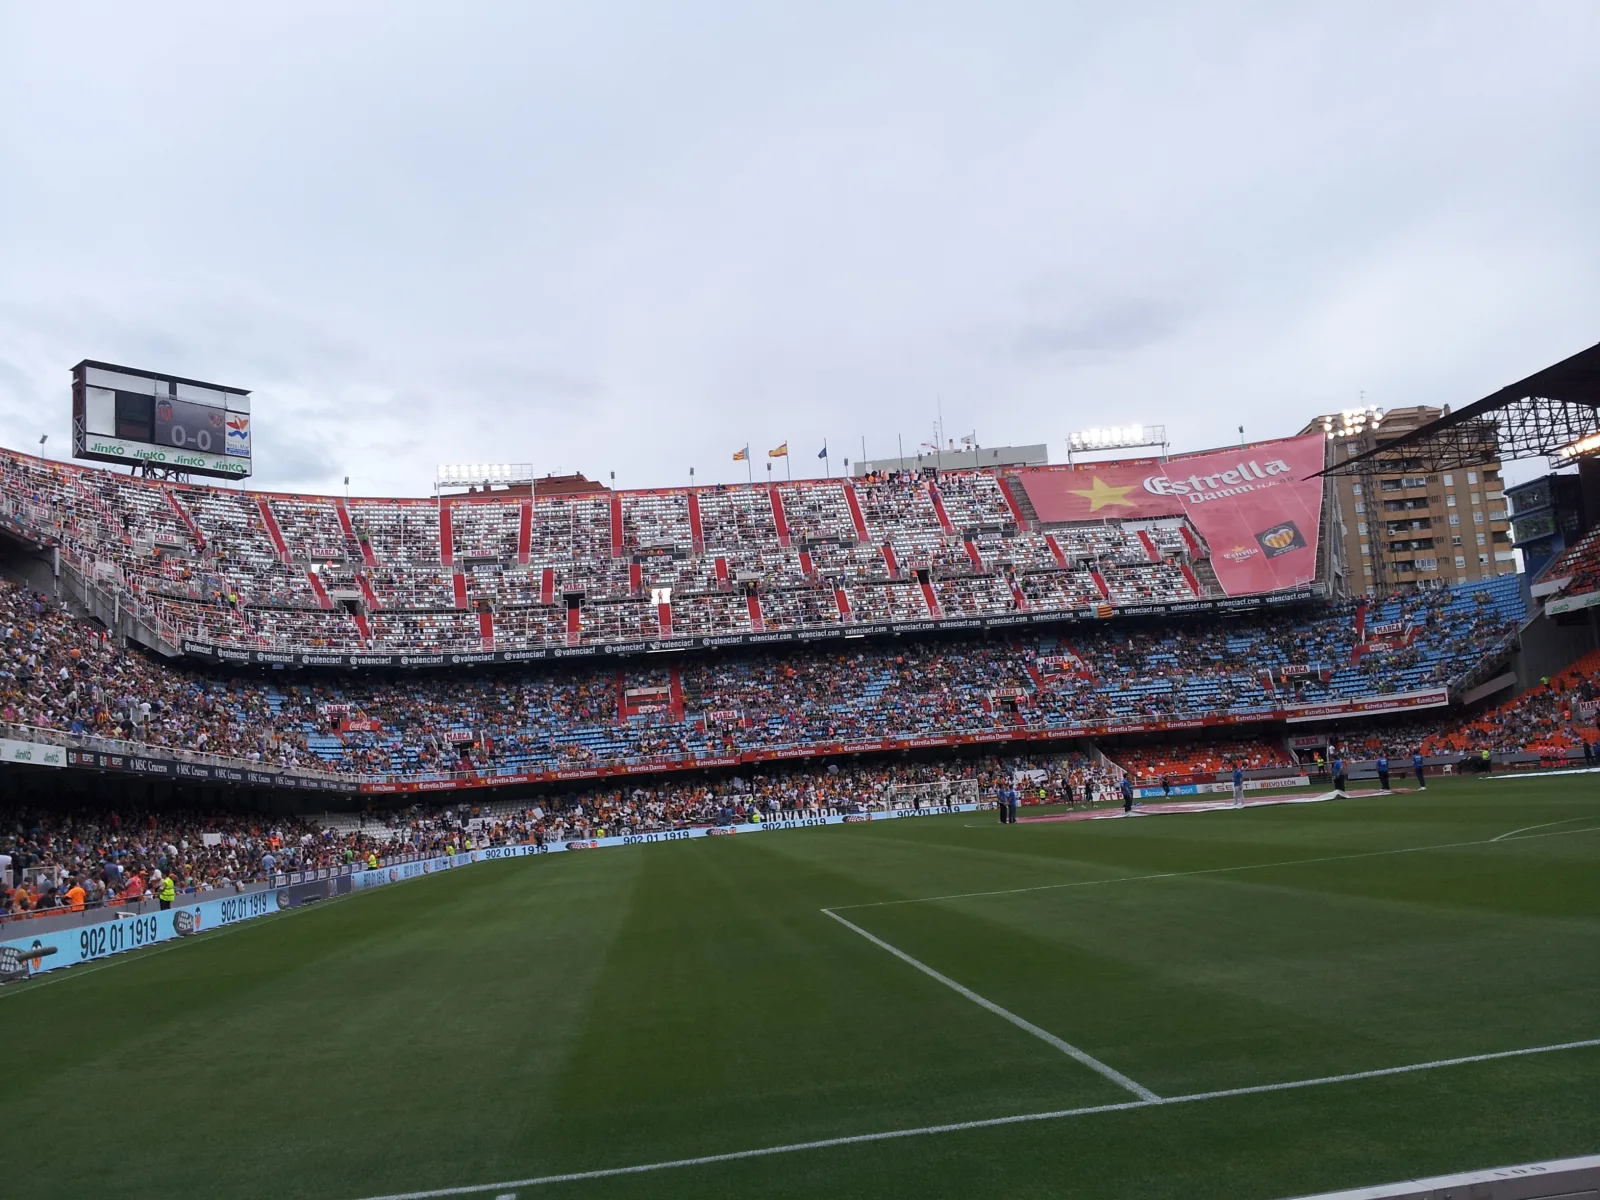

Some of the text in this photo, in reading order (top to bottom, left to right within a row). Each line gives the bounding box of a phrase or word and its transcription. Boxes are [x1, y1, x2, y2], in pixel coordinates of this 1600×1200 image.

[1142, 459, 1291, 496] Estrella
[1187, 483, 1256, 504] Damm
[154, 534, 175, 542] MARCA
[257, 652, 293, 662] @valenciacf
[302, 655, 342, 664] @valenciacf
[350, 656, 391, 665] @valenciacf
[401, 656, 443, 665] @valenciacf
[452, 653, 494, 664] @valenciacf
[504, 650, 546, 660] @valenciacf
[555, 647, 595, 657] @valenciacf
[605, 643, 645, 653] @valenciacf
[749, 633, 792, 642] valenciacf.com
[798, 630, 840, 638] valenciacf.com
[845, 626, 887, 635] valenciacf.com
[893, 623, 934, 631] valenciacf.com
[939, 619, 981, 628] valenciacf.com
[986, 616, 1028, 625] valenciacf.com
[1032, 613, 1073, 621] valenciacf.com
[1171, 602, 1212, 611] valenciacf.com
[1217, 598, 1260, 607] valenciacf.com
[1266, 593, 1310, 603] valenciacf.com
[1377, 623, 1400, 634] MARCA
[1284, 666, 1308, 674] MARCA
[713, 711, 736, 719] MARCA
[135, 760, 146, 771] MSC
[696, 758, 718, 767] Estrella
[180, 764, 190, 775] MSC
[624, 831, 689, 845] 902 01 1919
[486, 849, 500, 858] 902
[504, 848, 516, 856] 01
[222, 894, 266, 923] 902 01 1919
[81, 930, 105, 958] 902
[110, 924, 123, 951] 01
[130, 916, 156, 945] 1919
